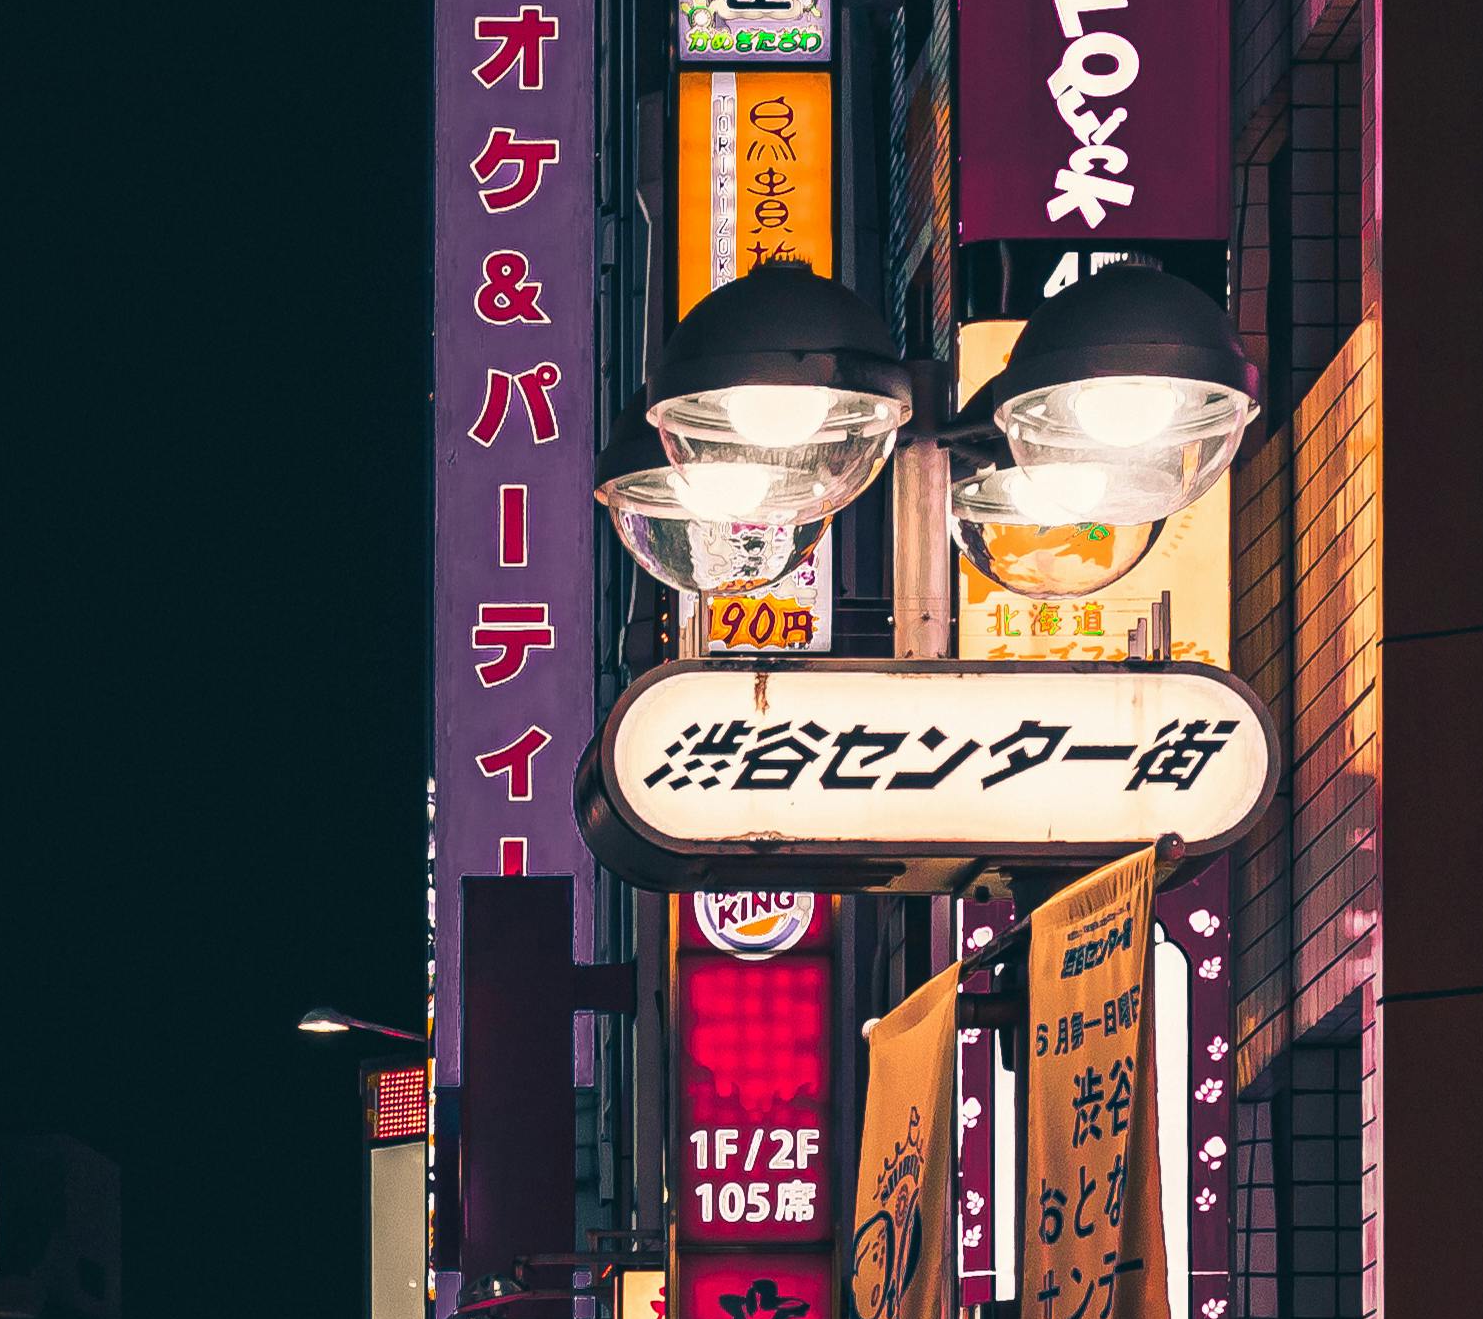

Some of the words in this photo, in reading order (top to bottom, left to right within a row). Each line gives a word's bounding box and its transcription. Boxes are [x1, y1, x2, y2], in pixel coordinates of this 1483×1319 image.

[987, 601, 1106, 637] 北海道
[643, 717, 1241, 792] 渋谷センター街
[716, 892, 797, 931] KING
[1071, 1056, 1135, 1149] 渋谷
[689, 1128, 821, 1174] 1F/2F
[694, 1181, 817, 1226] 105席
